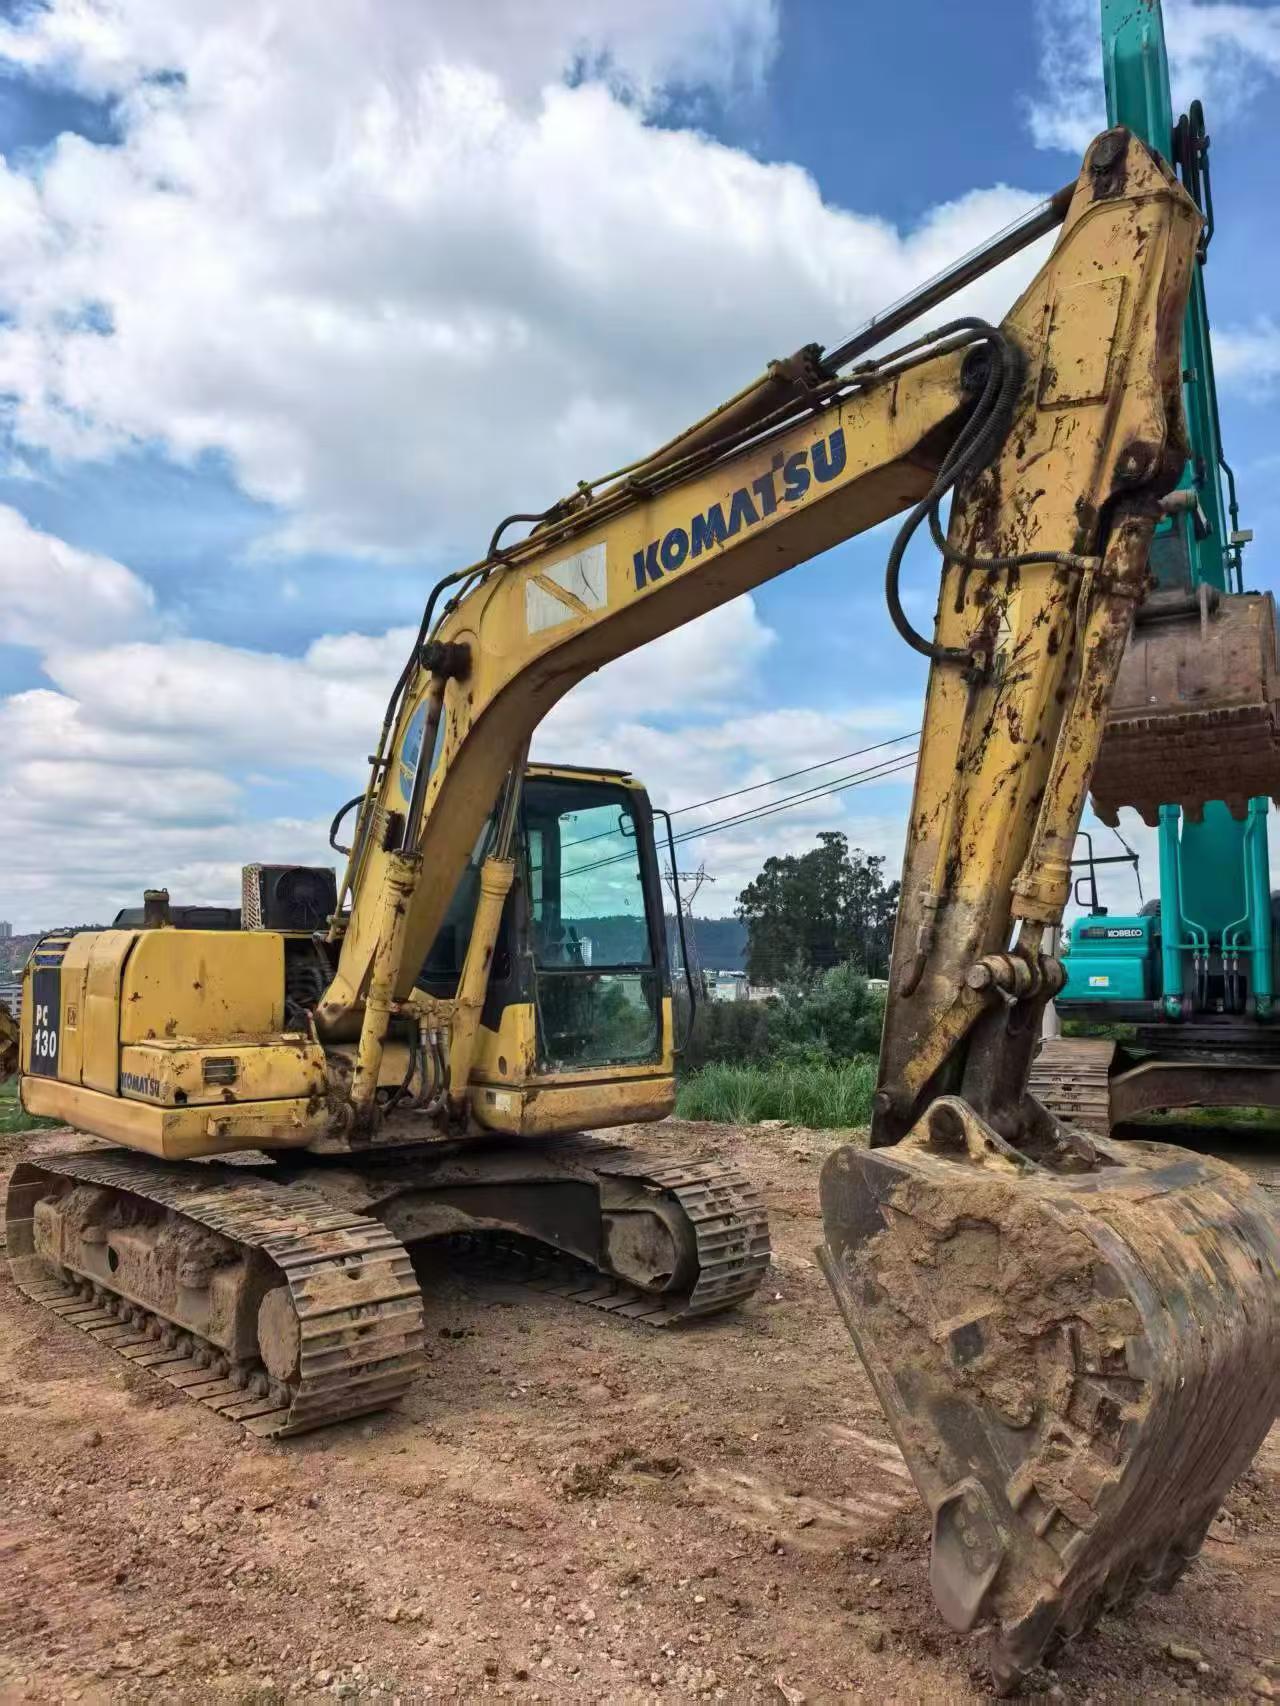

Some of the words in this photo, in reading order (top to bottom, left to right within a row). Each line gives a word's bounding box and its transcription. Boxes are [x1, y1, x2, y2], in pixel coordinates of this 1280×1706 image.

[633, 427, 847, 590] KOMATSU
[1107, 929, 1142, 937] KOBELCO
[36, 1004, 48, 1027] PC
[35, 1028, 57, 1058] 130
[121, 1071, 160, 1097] KOMATSU
